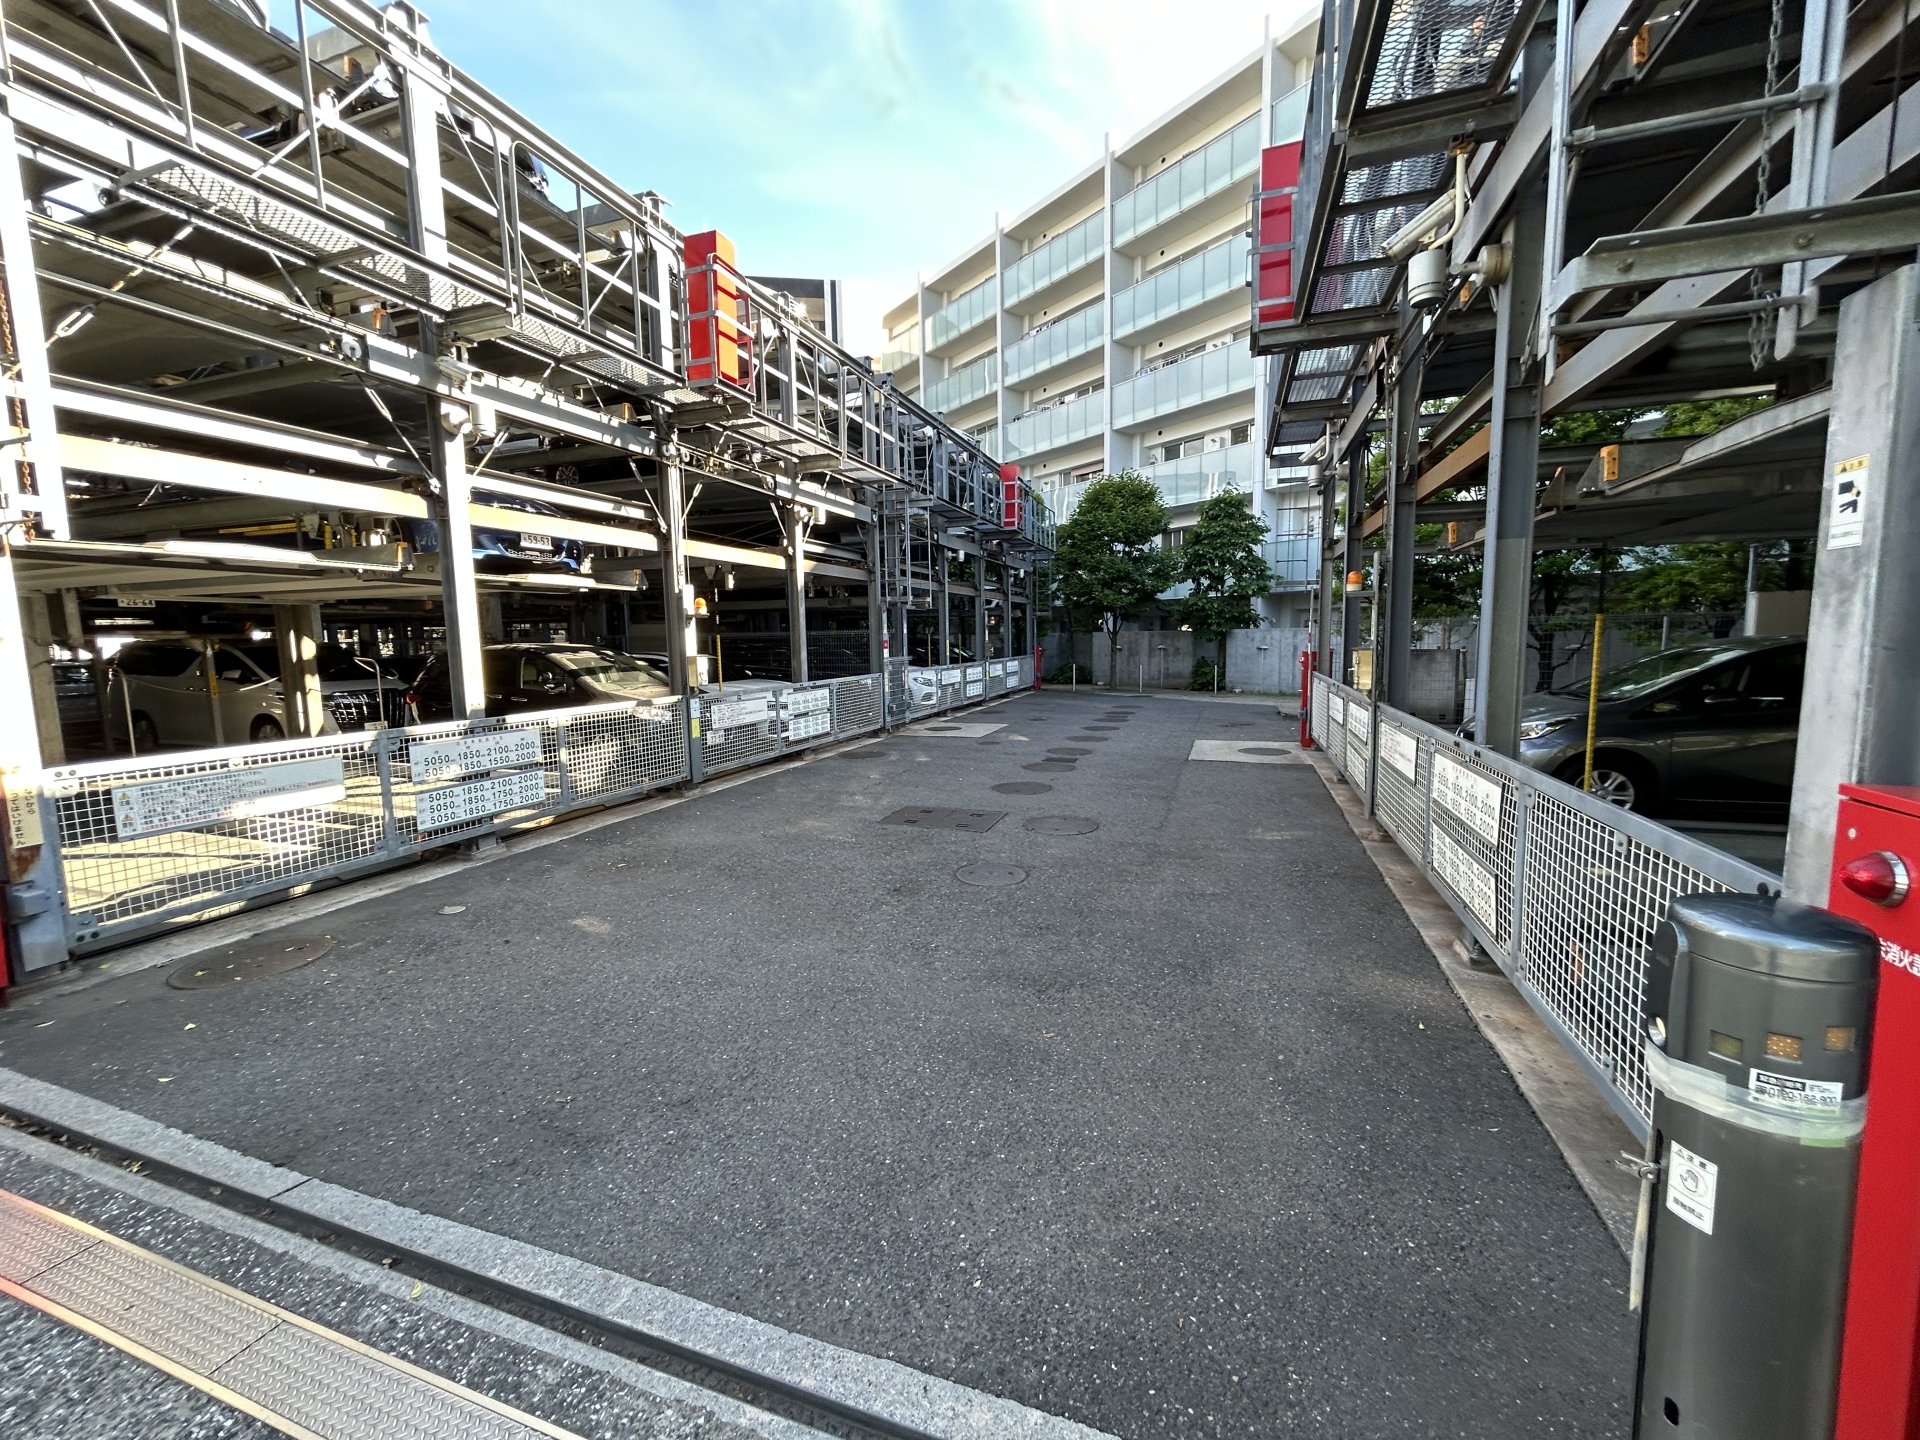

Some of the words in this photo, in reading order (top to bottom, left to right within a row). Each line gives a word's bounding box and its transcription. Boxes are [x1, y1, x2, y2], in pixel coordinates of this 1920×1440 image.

[423, 754, 450, 767] 5050
[457, 749, 481, 761] 1850
[486, 745, 509, 757] 2100
[514, 740, 536, 752] 2000
[425, 765, 451, 778] 5050
[458, 760, 482, 772] 1850
[488, 755, 510, 767] 1550
[515, 750, 536, 762] 2000
[428, 789, 454, 803] 5050
[461, 783, 485, 796] 1850
[490, 777, 513, 790] 2100
[518, 772, 539, 785] 2000
[429, 800, 455, 814] 5050
[462, 794, 486, 807] 1850
[492, 788, 514, 800] 1750
[518, 782, 540, 794] 2000
[430, 811, 456, 825] 5050
[463, 804, 487, 817] 1850
[493, 798, 514, 810] 1750
[519, 792, 540, 804] 2000
